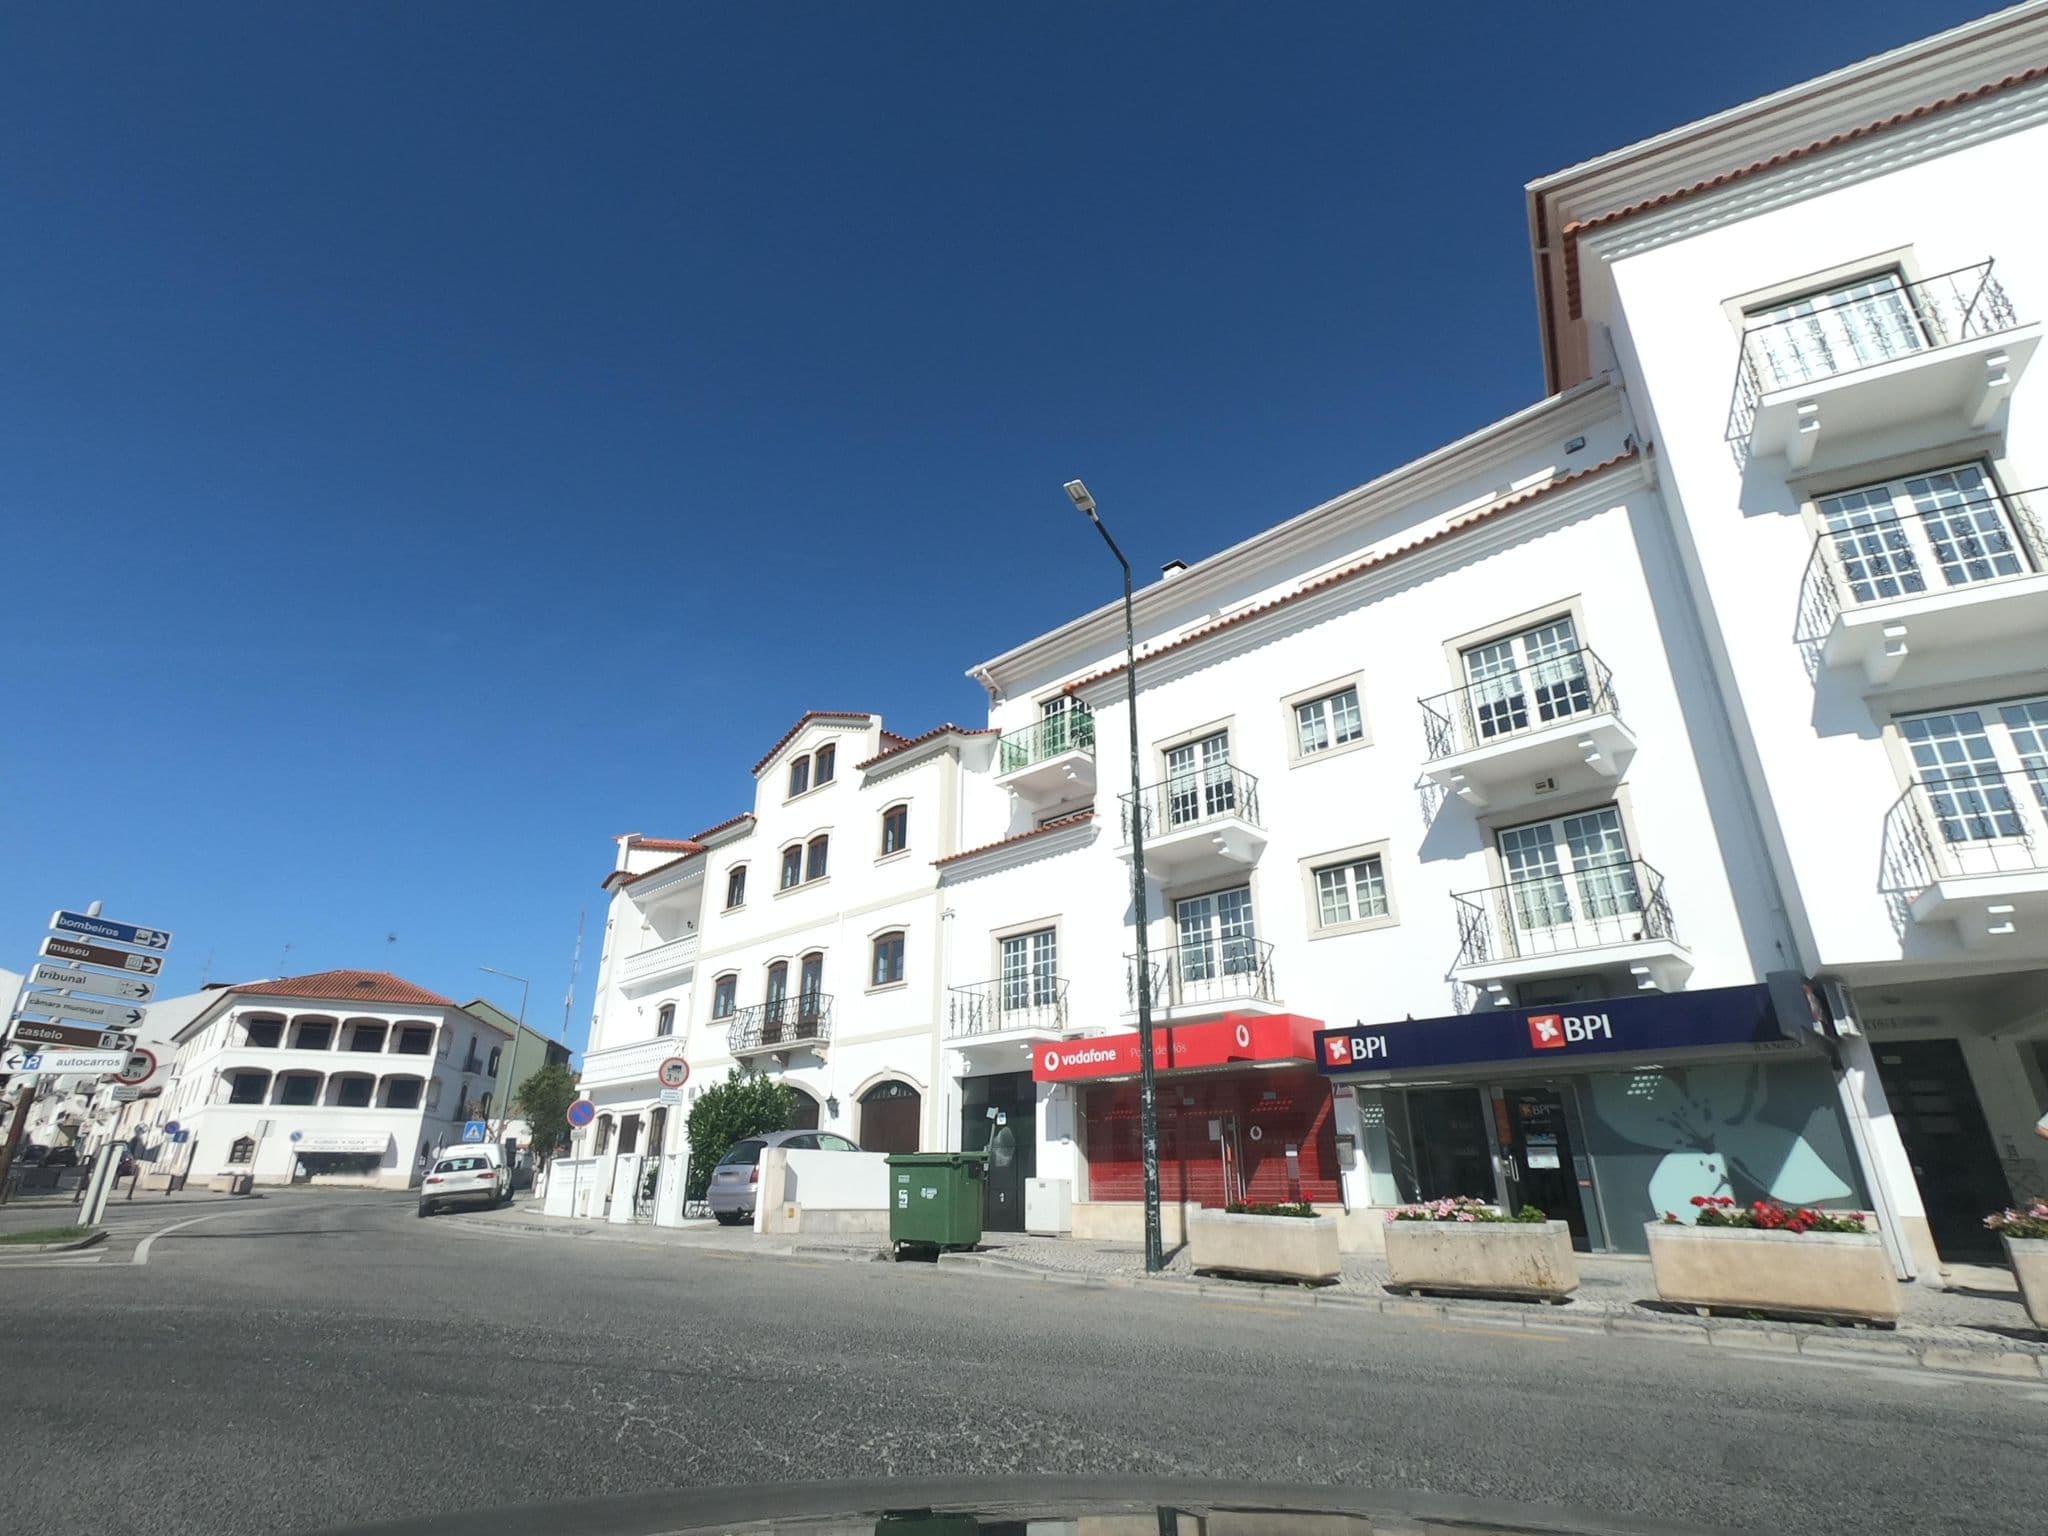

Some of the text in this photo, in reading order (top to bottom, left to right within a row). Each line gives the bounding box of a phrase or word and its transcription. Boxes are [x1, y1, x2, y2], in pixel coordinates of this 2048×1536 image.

[59, 916, 119, 937] bombeiros
[49, 942, 90, 957] museu
[39, 970, 86, 984] tribunal
[63, 1003, 105, 1016] municipal
[17, 1026, 63, 1040] castelo
[1564, 1014, 1612, 1043] BPI
[1351, 1036, 1388, 1060] BPI
[56, 1057, 121, 1067] autocarros
[1061, 1048, 1117, 1065] vodafone
